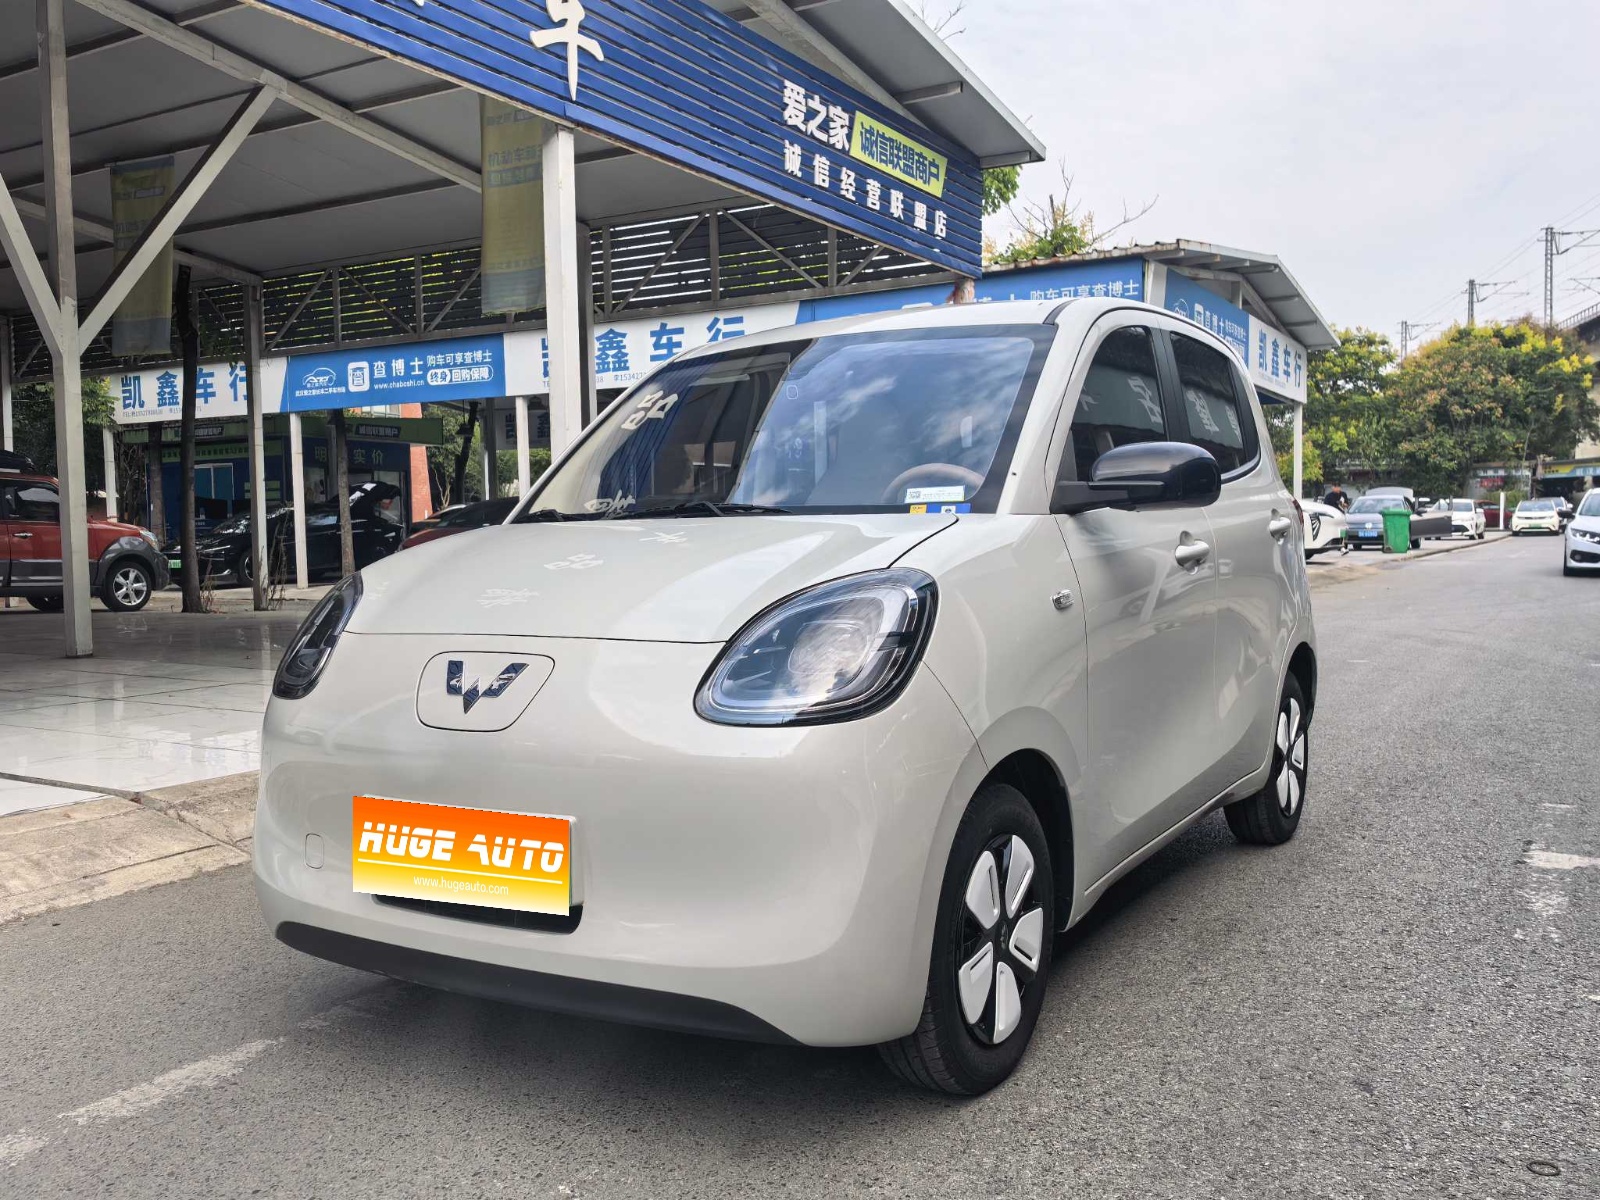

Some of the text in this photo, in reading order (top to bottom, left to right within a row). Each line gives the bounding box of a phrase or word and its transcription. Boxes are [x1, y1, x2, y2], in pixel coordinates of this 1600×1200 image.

[783, 79, 940, 187] 爱之家 诚信联盟商户
[784, 139, 947, 239] 诚信经营联盟店
[1030, 279, 1140, 301] 购车可享查博士
[373, 357, 424, 379] 查博士
[426, 349, 493, 368] 购车可享查博士
[541, 316, 744, 378] 鑫车行
[1258, 328, 1302, 388] 凯鑫车行
[121, 364, 248, 410] 凯鑫车行
[452, 366, 490, 382] 回购保障
